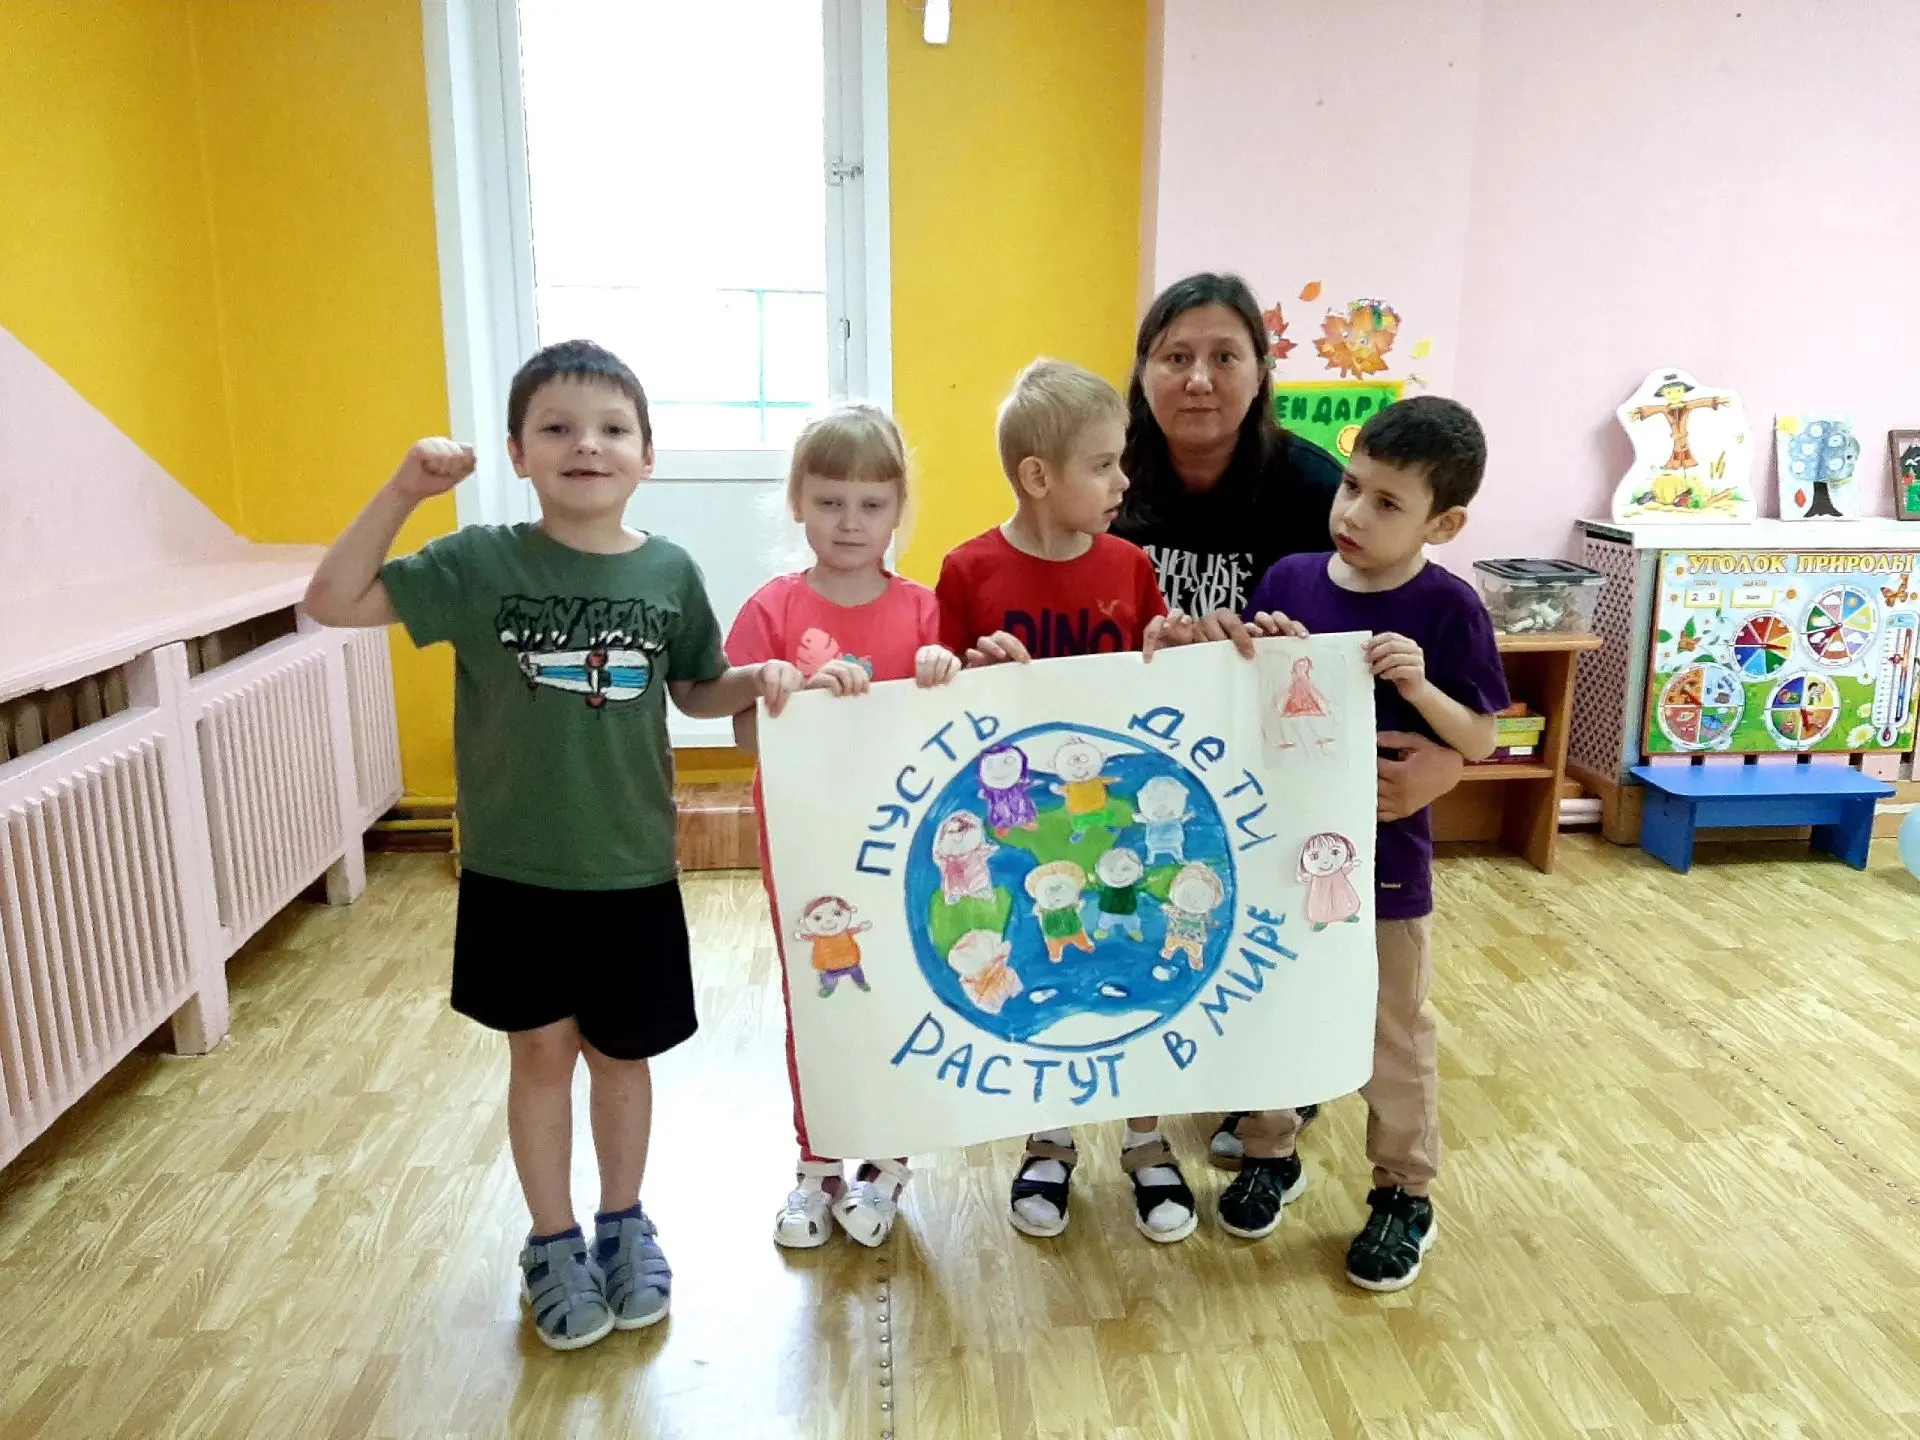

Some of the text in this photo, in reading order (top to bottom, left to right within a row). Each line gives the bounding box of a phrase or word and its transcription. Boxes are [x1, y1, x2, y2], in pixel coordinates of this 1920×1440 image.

[1688, 553, 1915, 576] УГОЛОК ПРИРОДЫ
[1004, 608, 1124, 658] DINO
[855, 709, 1000, 877] ПУСТЬ
[889, 1011, 1126, 1105] РАСТУТ
